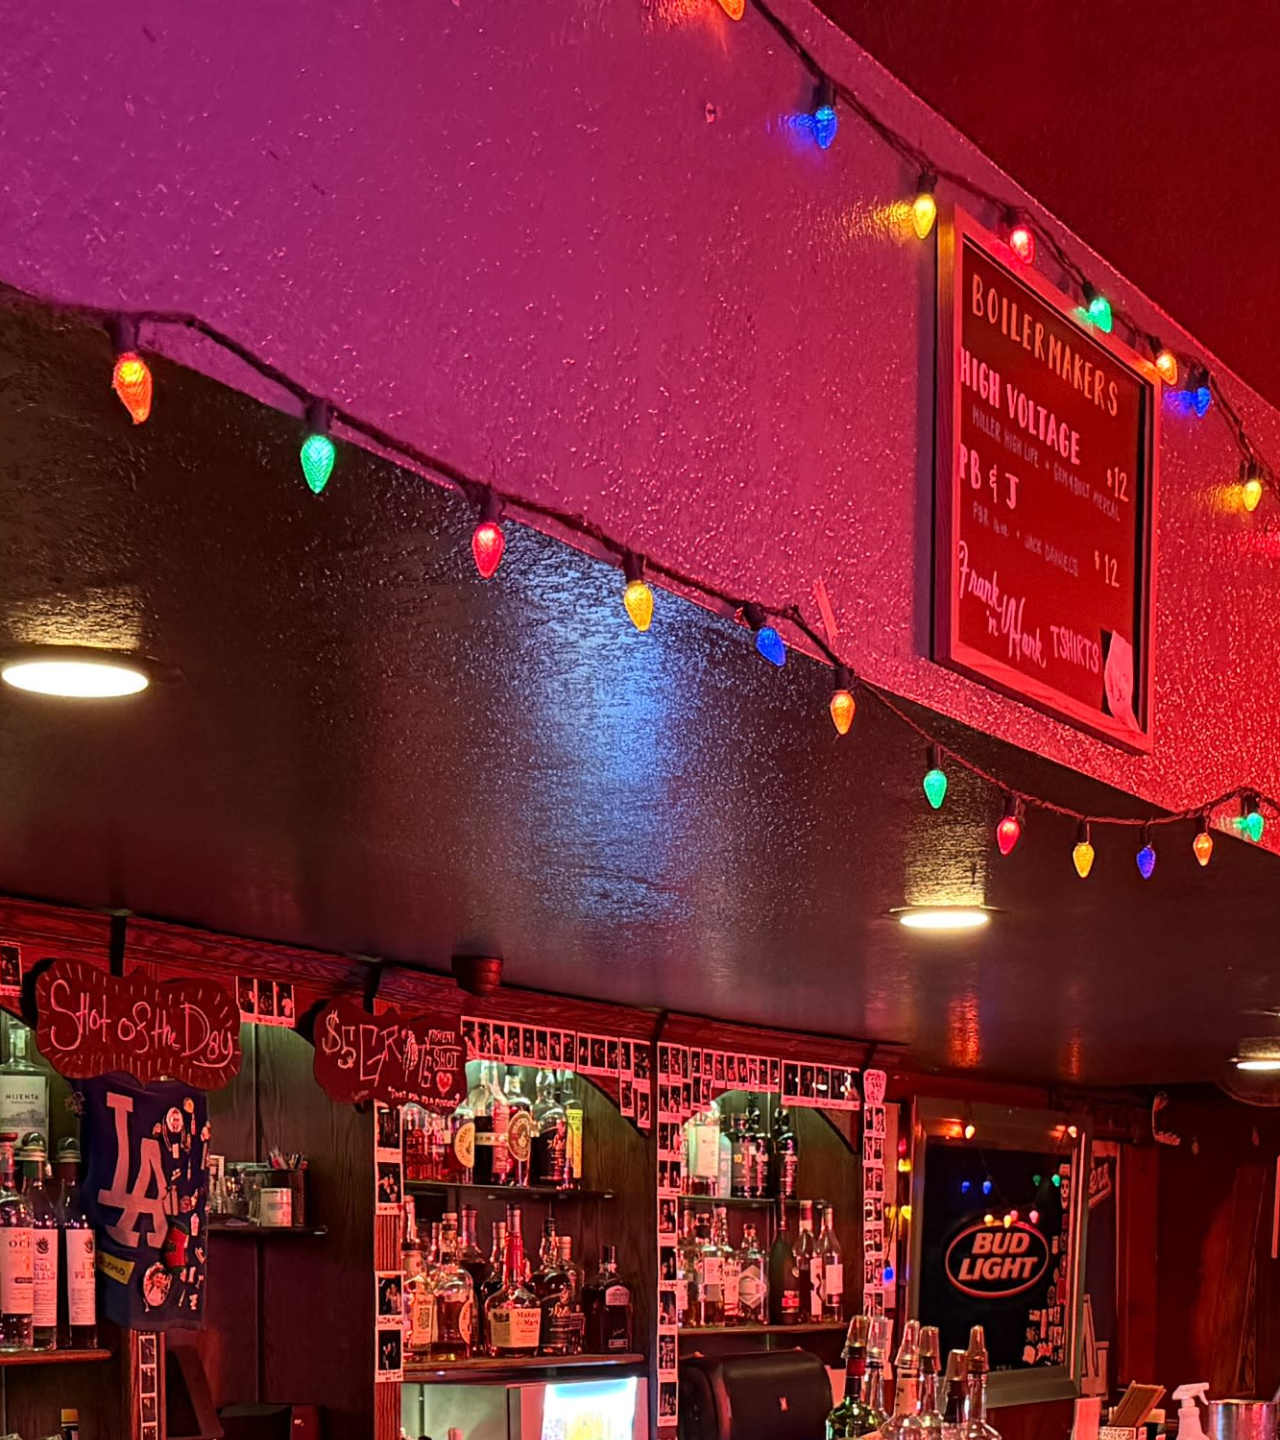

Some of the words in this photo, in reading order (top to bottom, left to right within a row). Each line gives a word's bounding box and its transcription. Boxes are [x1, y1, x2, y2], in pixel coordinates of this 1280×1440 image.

[972, 274, 1118, 417] BOILERMAKERS
[960, 347, 1000, 408] HIGH
[1007, 383, 1081, 465] VOLTAGE
[960, 443, 981, 490] PB
[1005, 472, 1019, 510] J
[1106, 465, 1129, 502] $12
[959, 540, 1003, 616] Frank
[97, 1091, 168, 1249] LA
[958, 1257, 1038, 1281] LIGHT
[972, 1233, 1030, 1254] BUD
